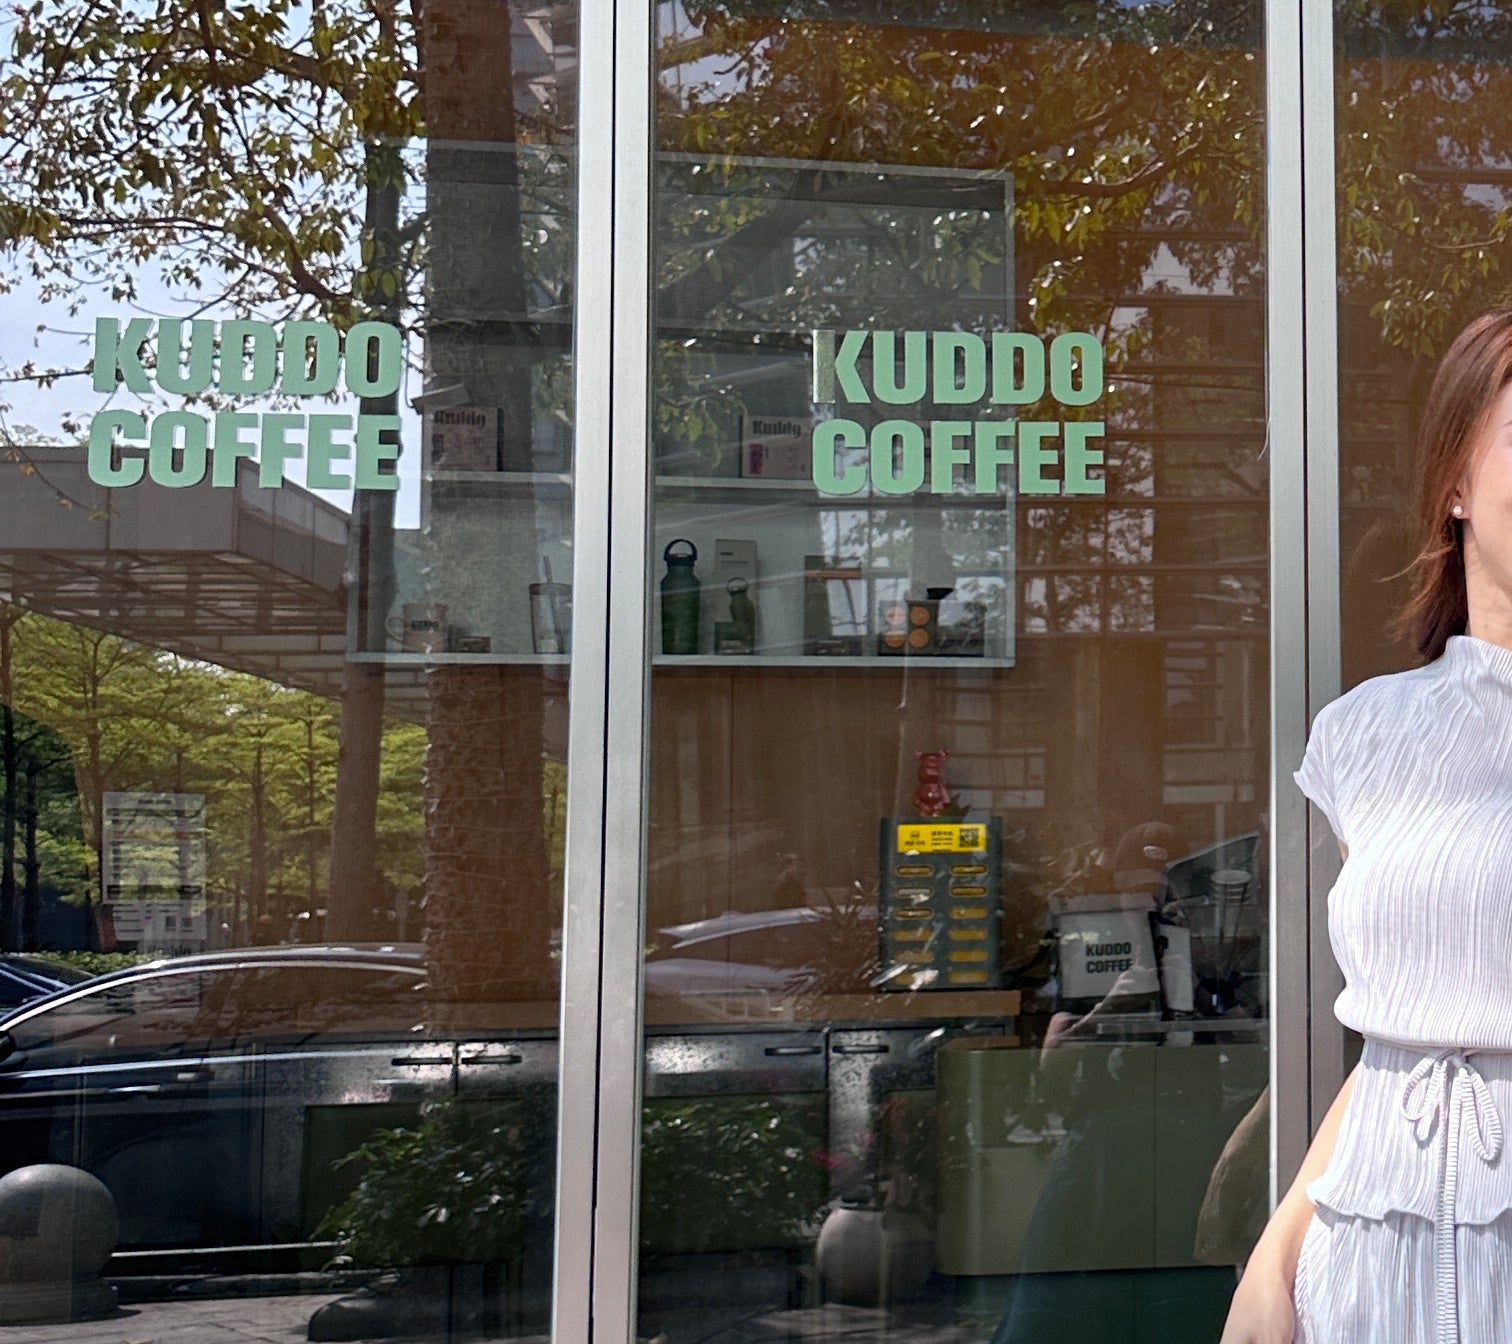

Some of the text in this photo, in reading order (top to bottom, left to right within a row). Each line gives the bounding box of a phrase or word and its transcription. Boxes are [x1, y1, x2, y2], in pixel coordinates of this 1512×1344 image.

[93, 317, 402, 397] KUDDO
[812, 329, 1104, 405] KUDDO
[87, 409, 401, 490] COFFEE
[812, 418, 1106, 495] COFFEE
[1086, 942, 1132, 957] KUDDO
[1086, 959, 1133, 973] COFFEE
